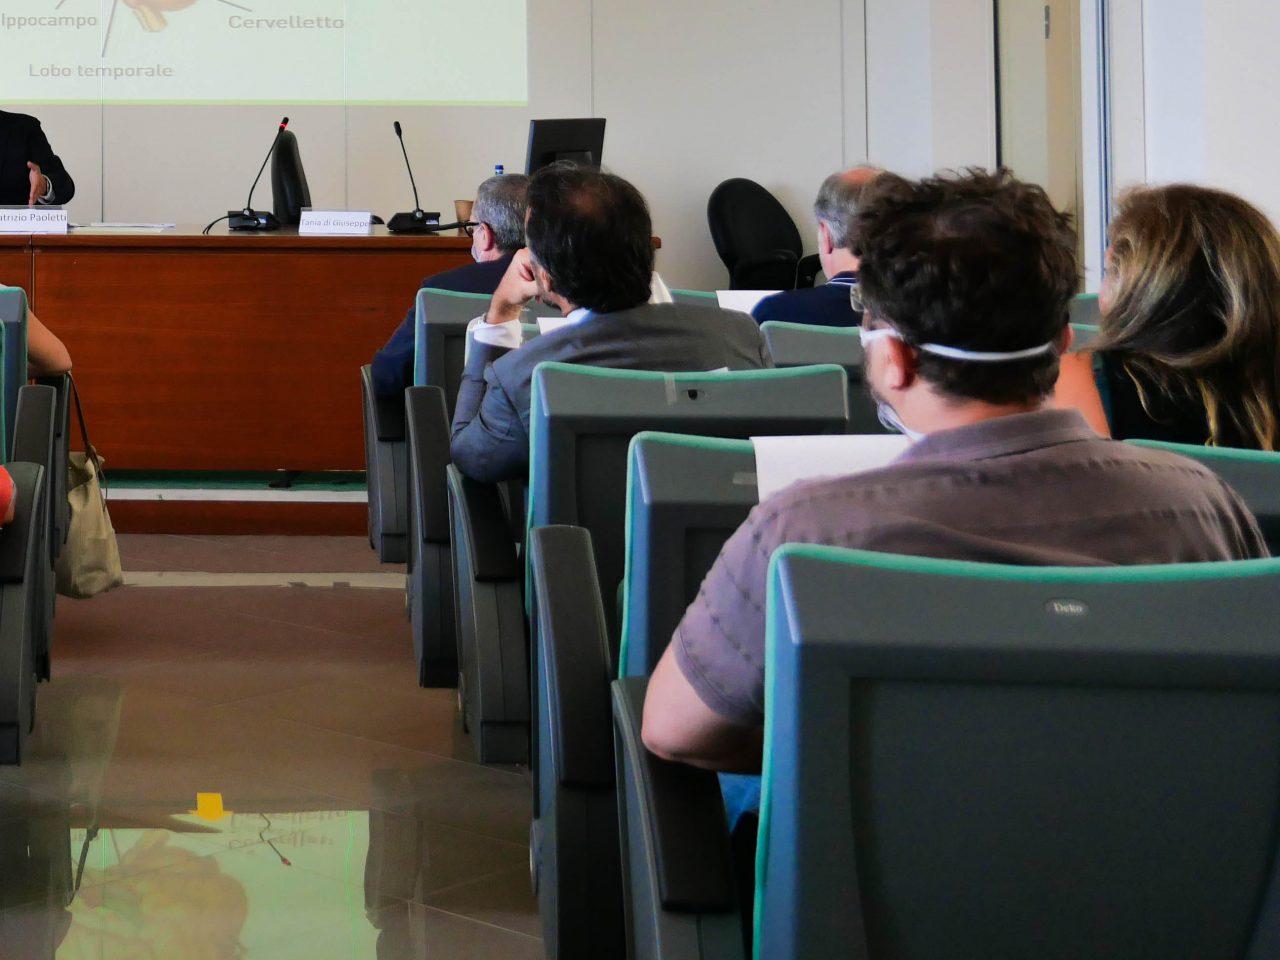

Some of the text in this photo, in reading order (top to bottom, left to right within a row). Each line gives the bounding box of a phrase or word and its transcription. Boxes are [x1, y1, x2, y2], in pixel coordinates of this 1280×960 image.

[1, 12, 98, 31] Ippocampo
[228, 15, 345, 29] Cervelletto
[29, 63, 173, 81] Lobo temporale
[30, 213, 67, 222] Paoletti
